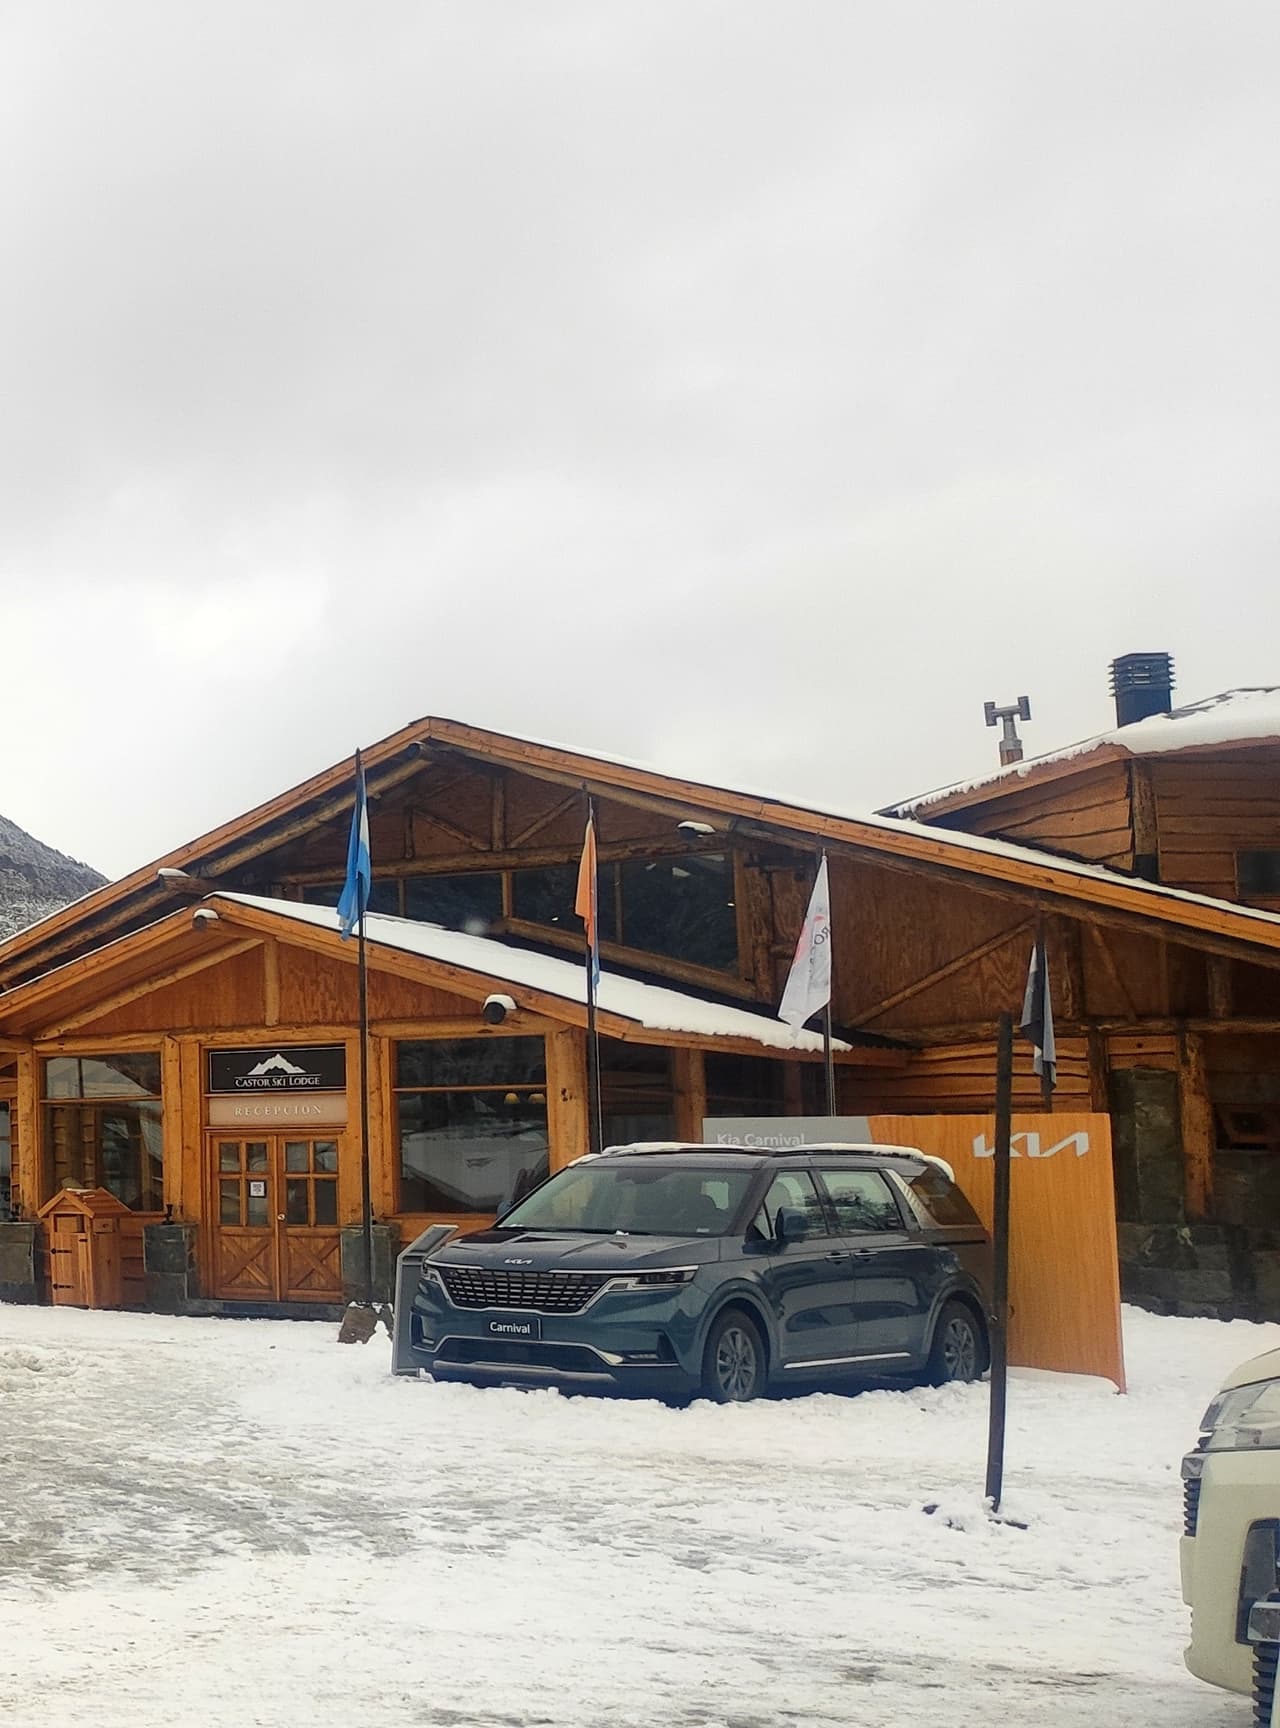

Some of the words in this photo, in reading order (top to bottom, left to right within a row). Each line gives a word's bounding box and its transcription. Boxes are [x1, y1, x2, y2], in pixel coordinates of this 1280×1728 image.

[235, 1077, 269, 1087] CASTOR
[272, 1077, 286, 1087] SKI
[289, 1076, 320, 1086] LODGE
[716, 1133, 740, 1145] Kia
[744, 1133, 805, 1146] Carnival
[490, 1321, 531, 1334] Carnival
